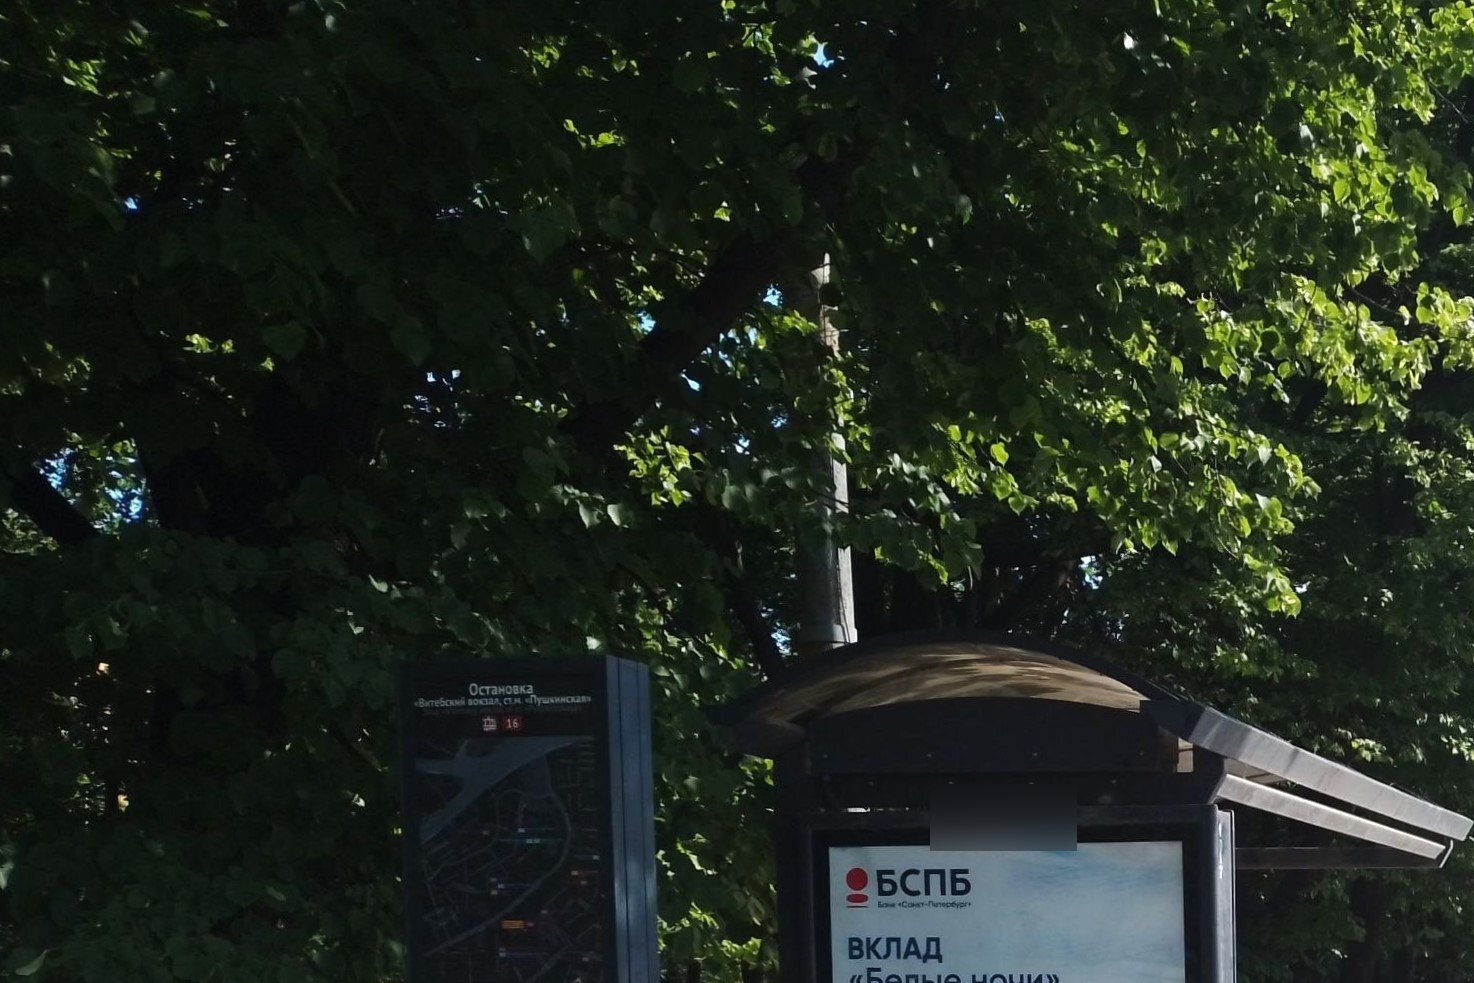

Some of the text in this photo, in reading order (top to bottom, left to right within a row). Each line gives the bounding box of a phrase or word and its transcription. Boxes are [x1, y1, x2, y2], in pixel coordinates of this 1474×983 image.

[469, 682, 534, 696] Остановка
[414, 697, 466, 708] «Витебский
[468, 697, 502, 707] вокзал,
[525, 694, 592, 707] «Пушкинская»
[506, 718, 519, 728] 16
[876, 869, 972, 897] БСПБ
[848, 937, 943, 963] ВКЛАД
